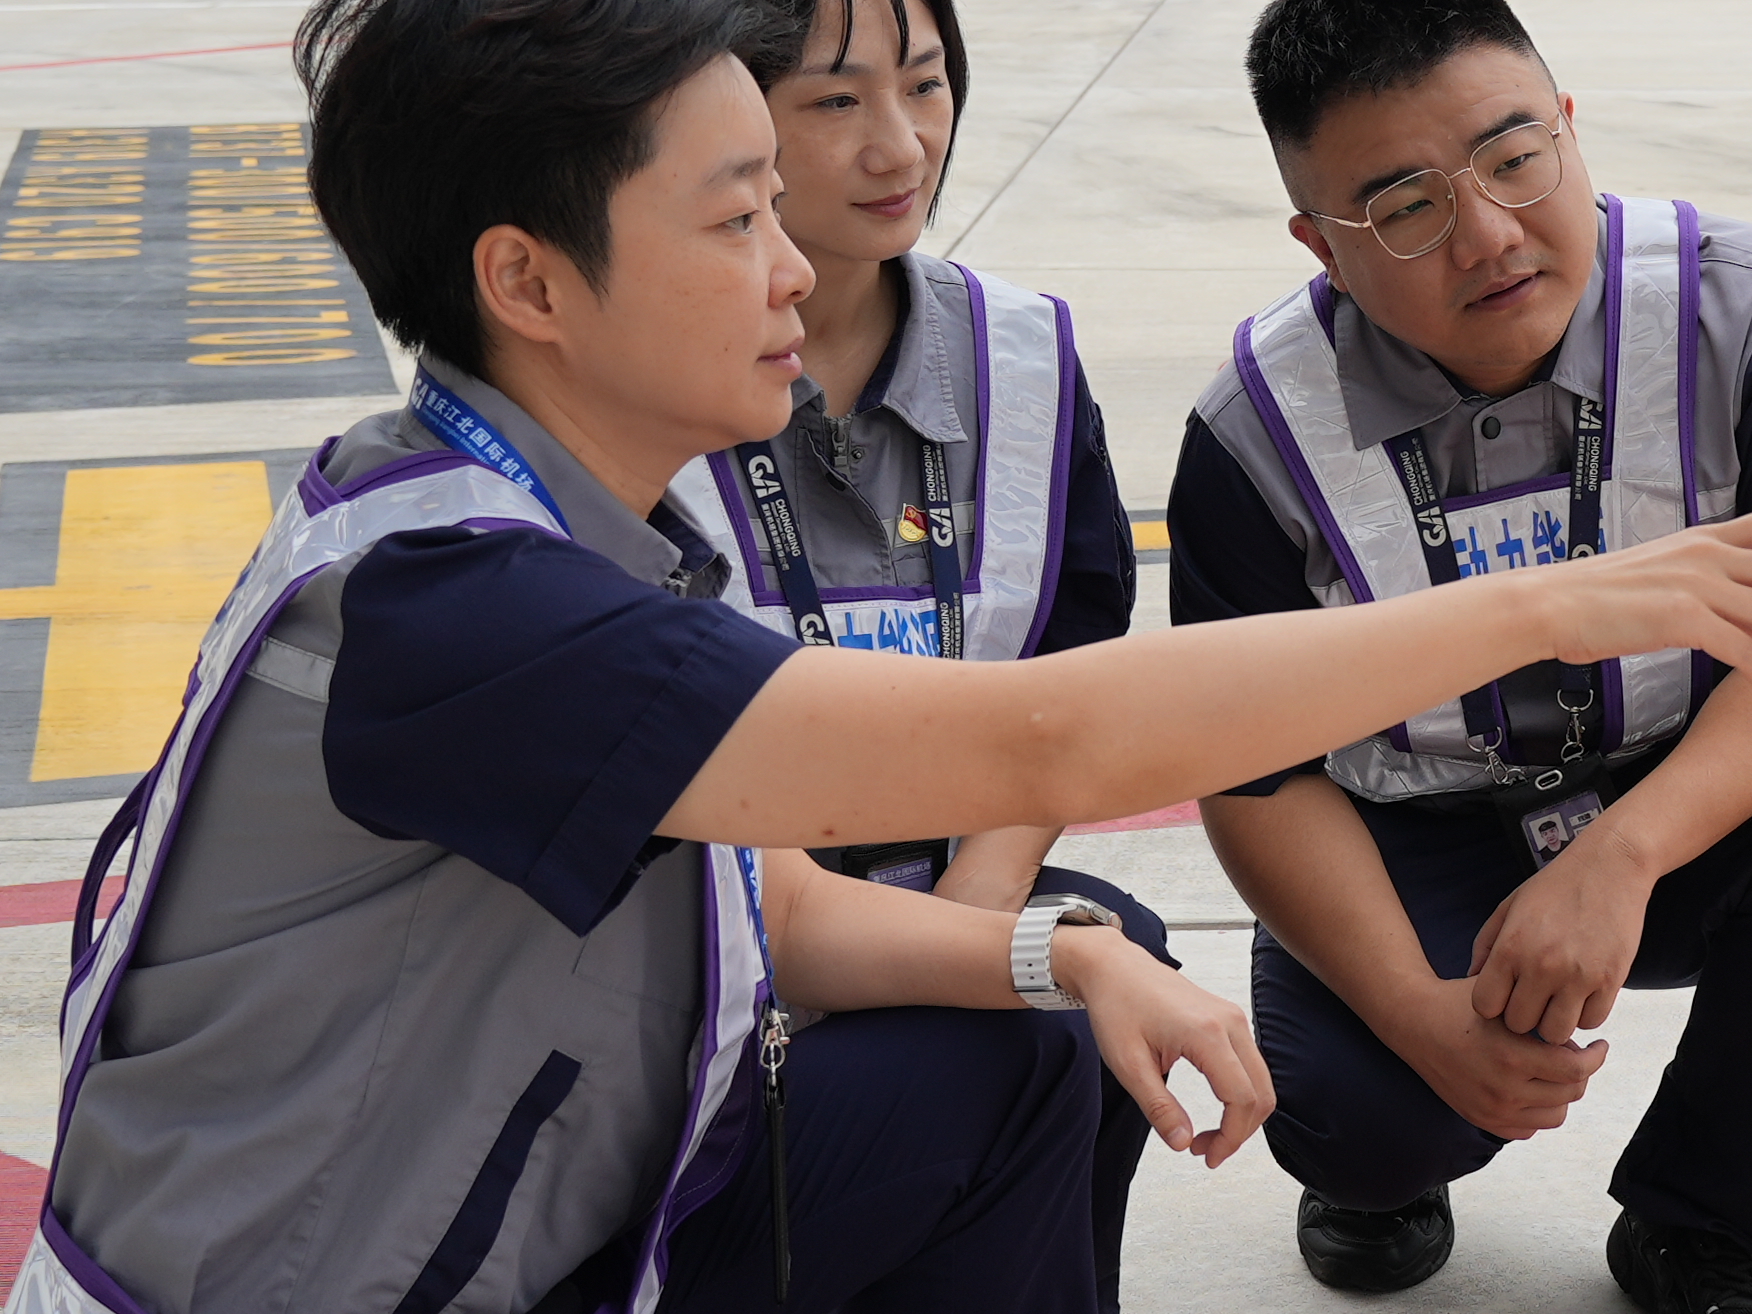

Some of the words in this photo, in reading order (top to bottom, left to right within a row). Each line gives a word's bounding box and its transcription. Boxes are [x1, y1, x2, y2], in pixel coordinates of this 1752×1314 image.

[12, 166, 147, 208] A320
[425, 389, 536, 493] 重庆江北国际机场
[1588, 436, 1601, 492] CHONGQING
[923, 444, 937, 502] CHONGQING
[1400, 450, 1423, 506] CHONGQING
[774, 498, 801, 557] CHONGQING
